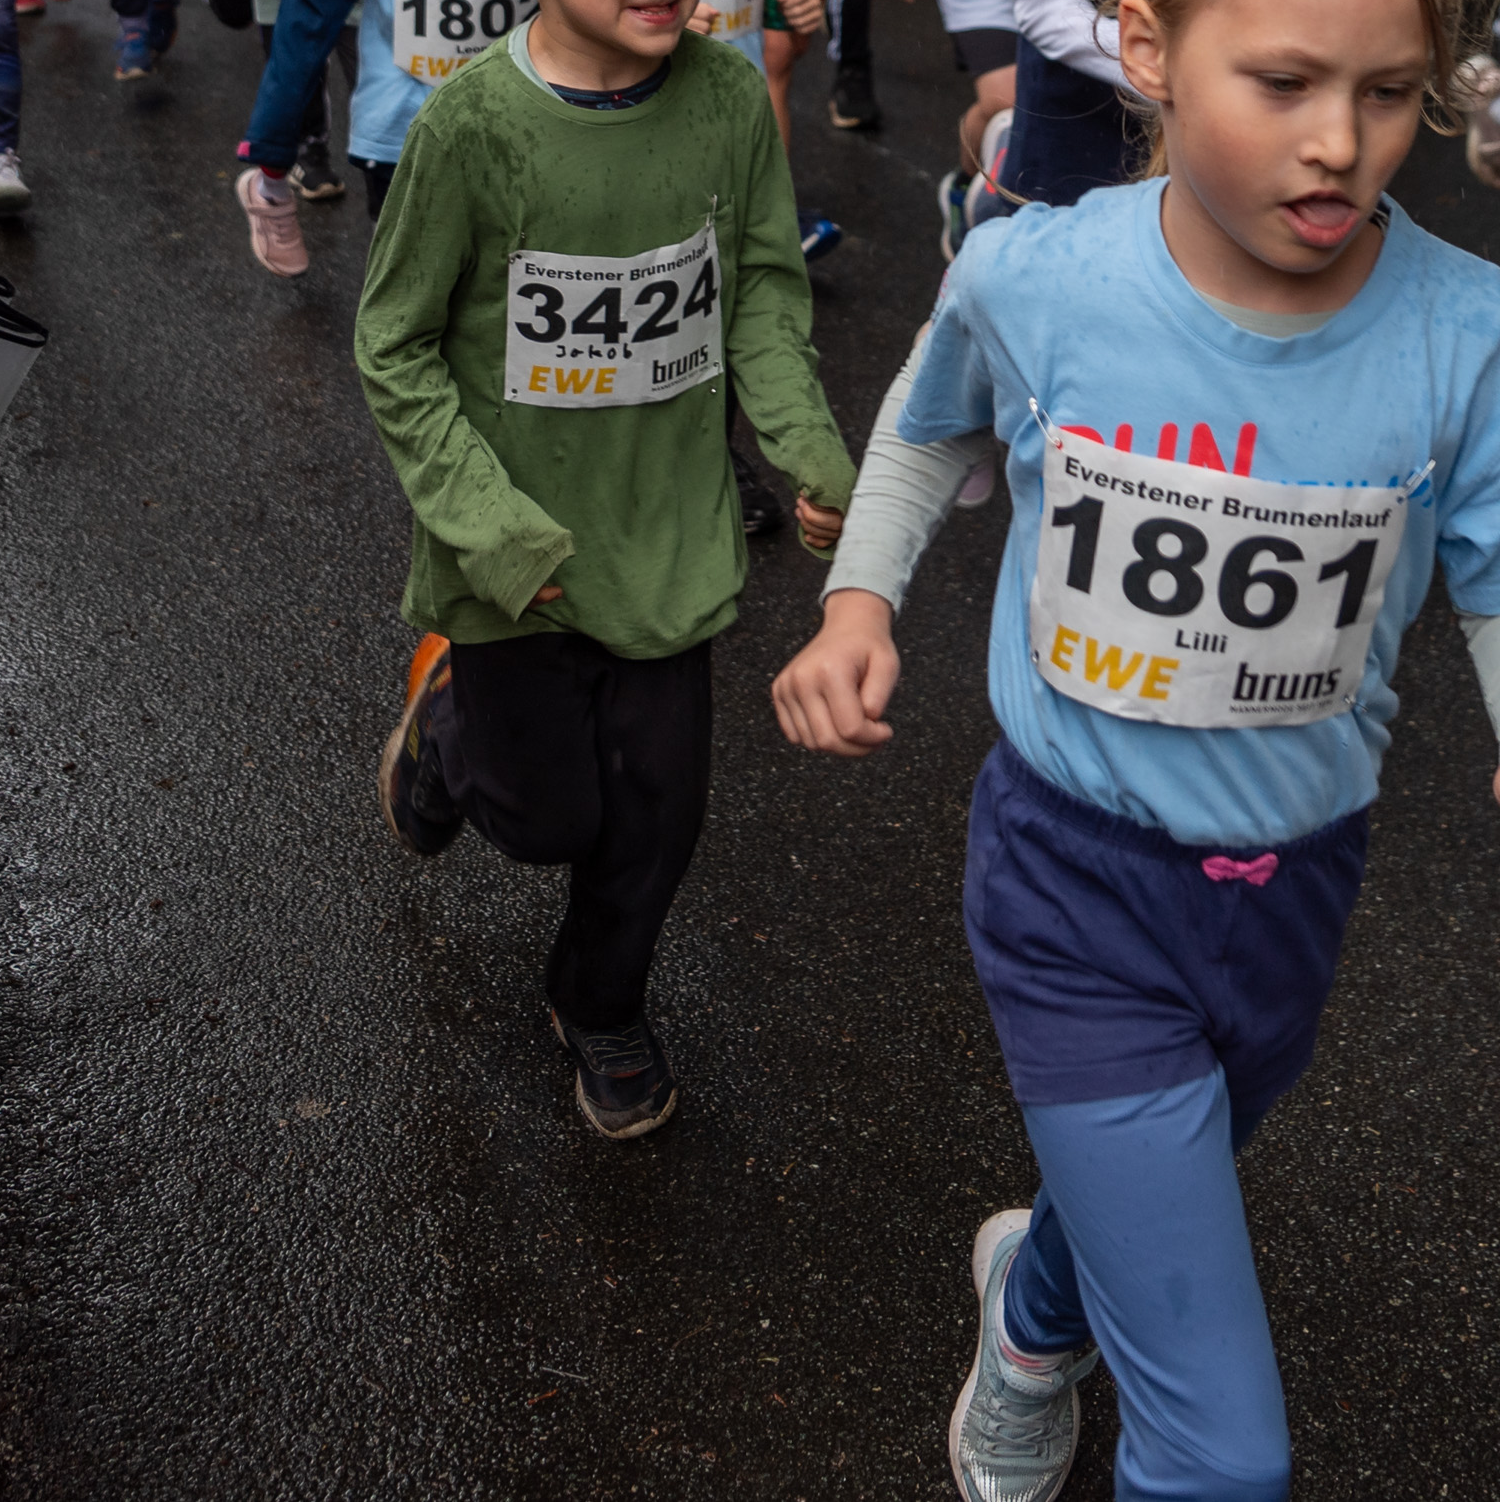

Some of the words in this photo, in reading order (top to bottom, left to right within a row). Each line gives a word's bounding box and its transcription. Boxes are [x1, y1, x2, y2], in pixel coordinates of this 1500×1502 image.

[409, 54, 468, 79] EW
[524, 262, 624, 282] Everstener
[514, 256, 719, 345] 3424
[555, 344, 633, 360] Jakob
[652, 344, 709, 385] bruns
[528, 365, 618, 395] EWE
[1065, 456, 1210, 512] Everstener
[1222, 496, 1393, 529] Brunnenlauf
[1051, 495, 1380, 630] 1861
[1175, 629, 1229, 655] Lilli
[1050, 624, 1180, 702] EWE
[1232, 662, 1342, 702] bruns
